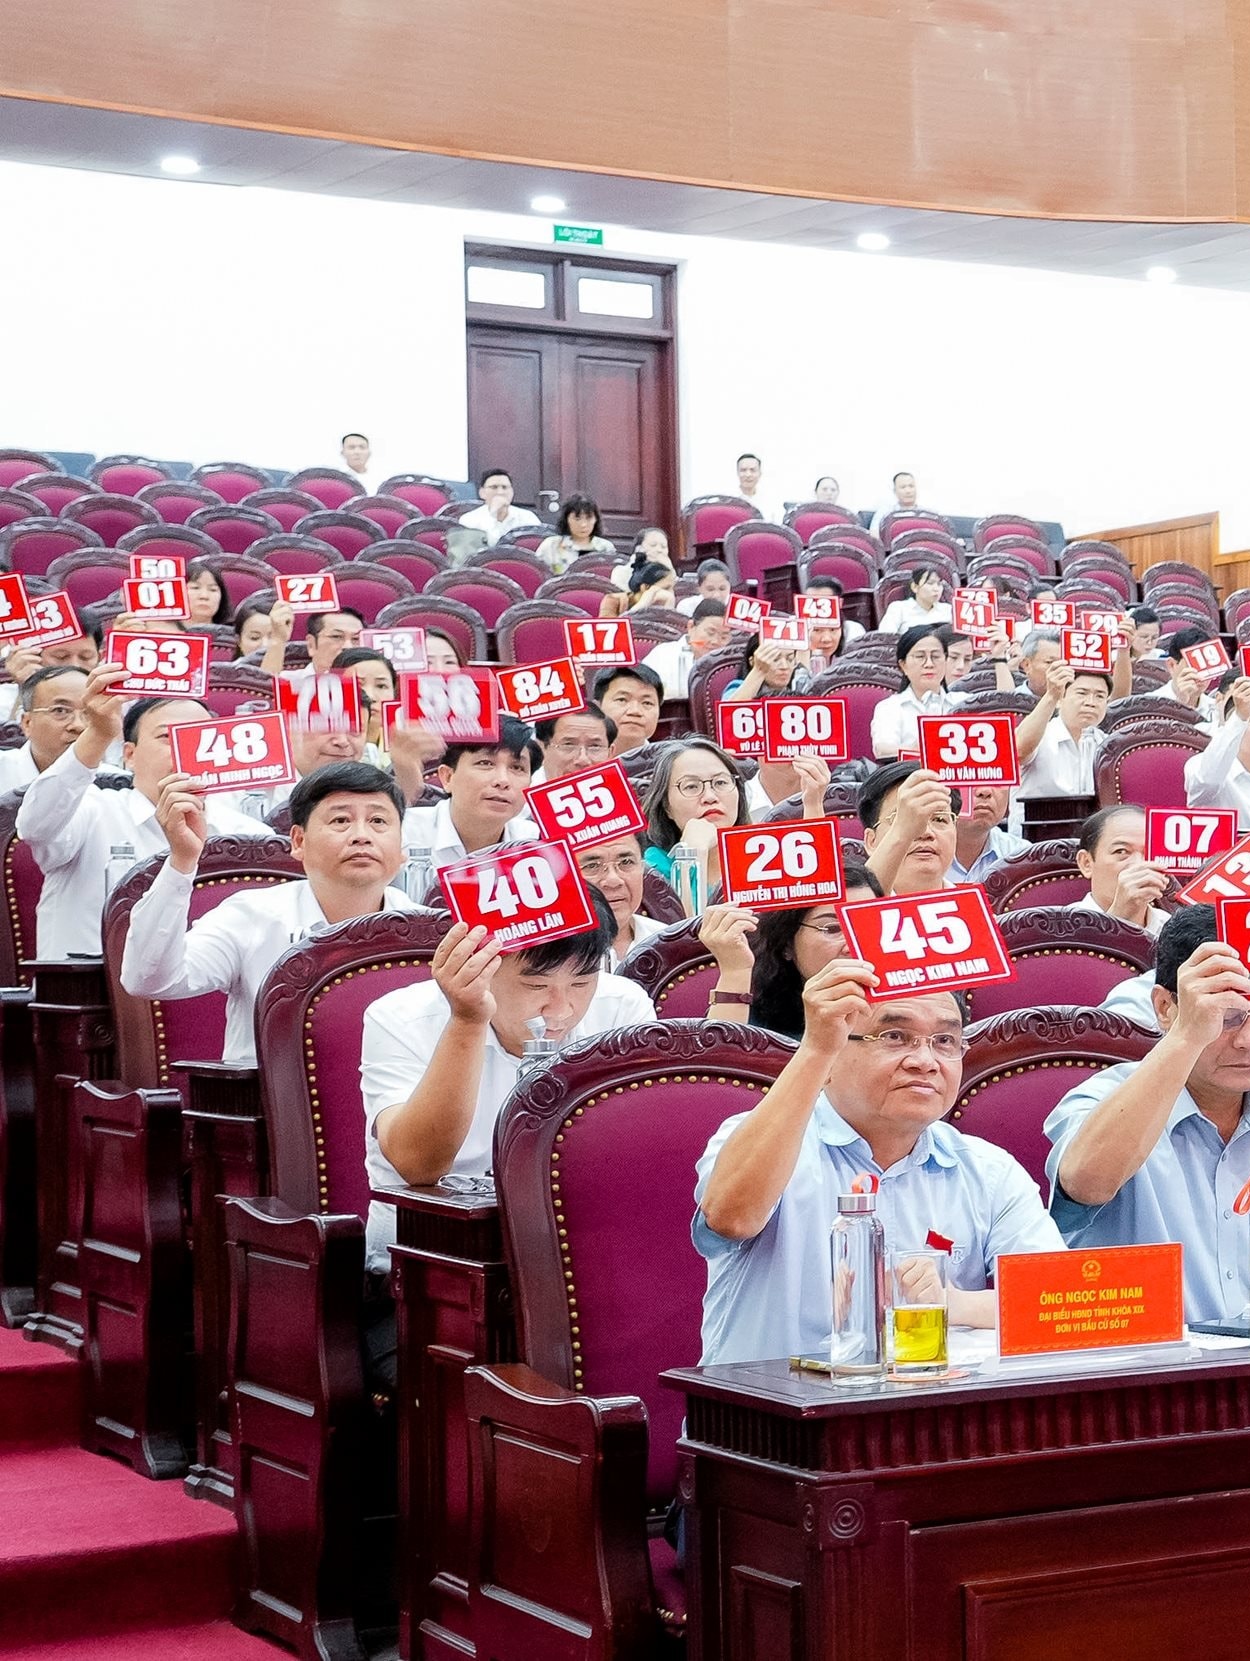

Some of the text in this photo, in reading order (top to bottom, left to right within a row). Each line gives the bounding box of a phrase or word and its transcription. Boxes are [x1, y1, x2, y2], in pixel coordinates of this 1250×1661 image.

[137, 581, 176, 607] 01
[287, 578, 325, 601] 27
[31, 599, 63, 630] 3
[734, 599, 761, 622] 04
[803, 598, 832, 618] 43
[960, 603, 985, 626] 41
[1039, 603, 1068, 624] 35
[577, 623, 618, 651] 17
[770, 620, 798, 640] 71
[1089, 615, 1118, 636] 29
[126, 638, 190, 677] 63
[372, 633, 414, 660] 53
[1070, 633, 1102, 658] 52
[1191, 644, 1221, 670] 19
[512, 667, 565, 704] 84
[780, 705, 832, 741] 80
[196, 722, 268, 767] 48
[938, 722, 998, 764] 33
[219, 769, 250, 783] MINH
[252, 764, 284, 780] NGỌC
[546, 774, 615, 828] 55
[576, 814, 631, 844] XUÂN QUANG
[1164, 815, 1219, 853] 07
[744, 831, 818, 882] 26
[477, 856, 559, 918] 40
[733, 881, 837, 903] NGUYỄN THỊ HỒNG HOA
[494, 912, 565, 943] HOÀNG LÂN
[880, 900, 972, 960] 45
[885, 957, 990, 987] NGỌC KIM NAM
[1040, 1287, 1143, 1306] ÔNG NGỌC KIM NAM
[1133, 1305, 1145, 1314] XIX
